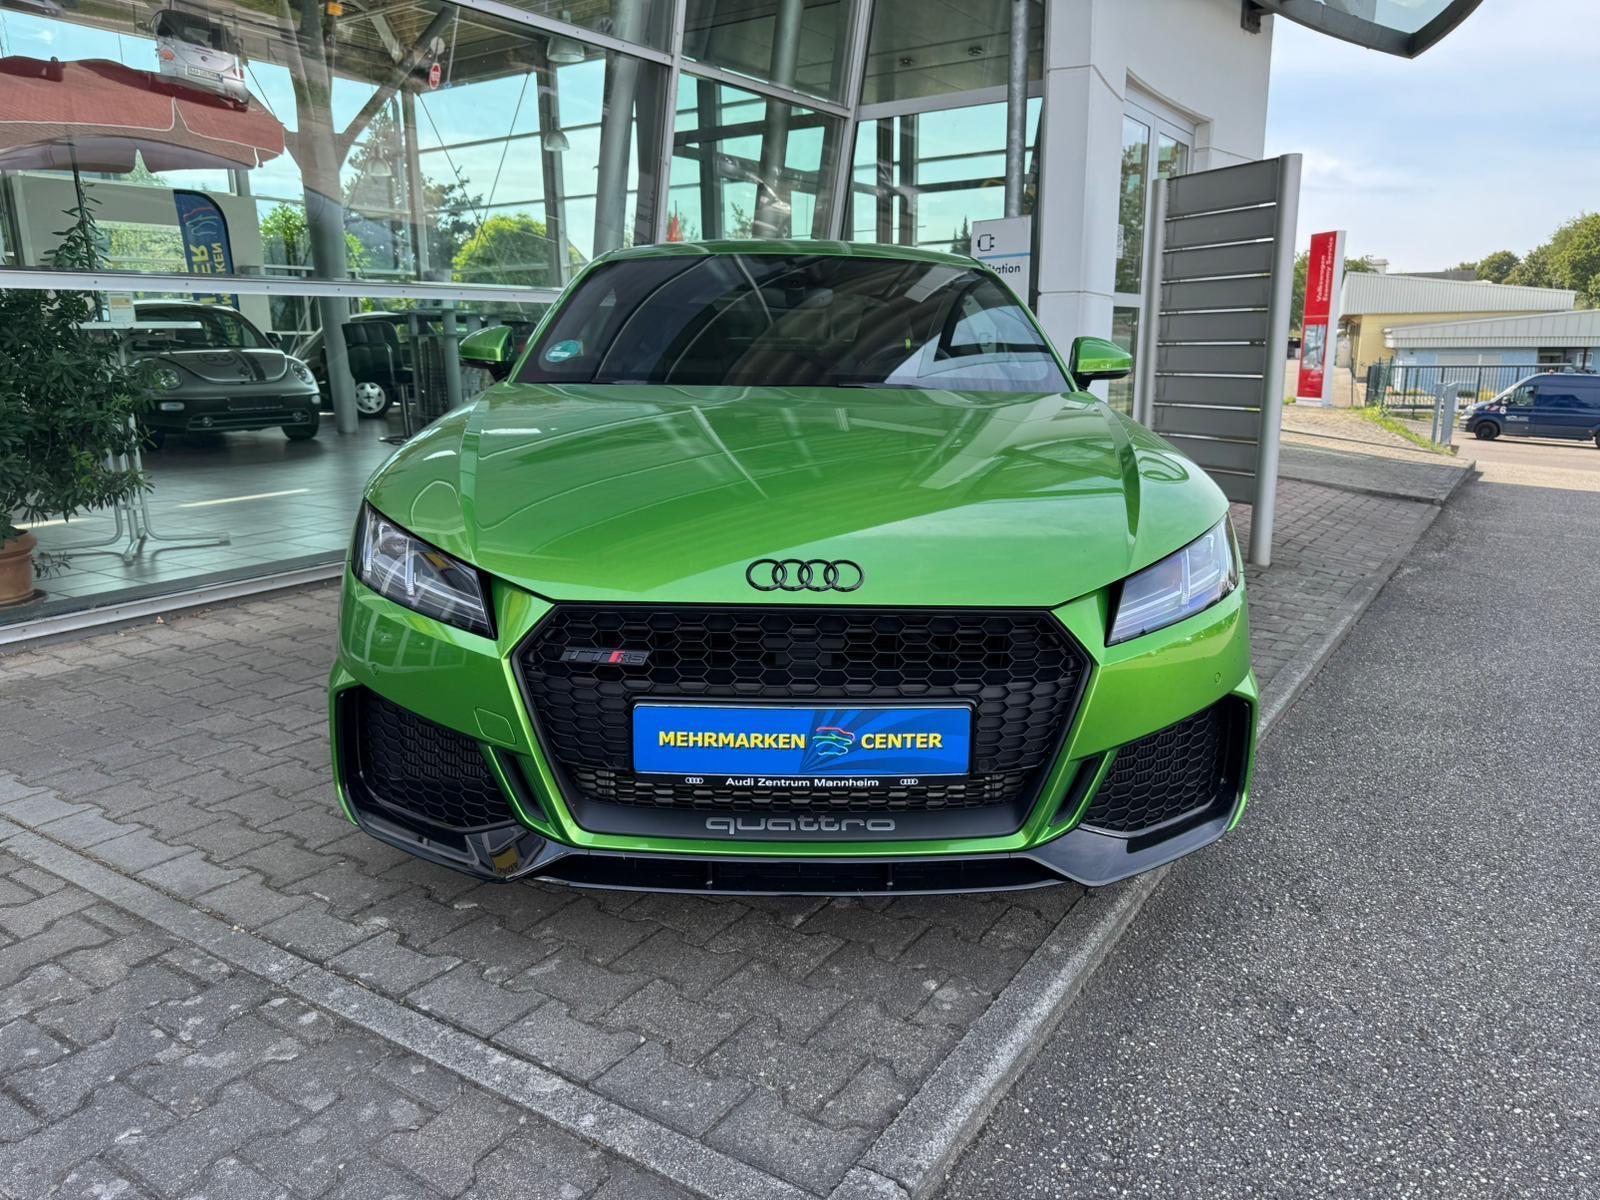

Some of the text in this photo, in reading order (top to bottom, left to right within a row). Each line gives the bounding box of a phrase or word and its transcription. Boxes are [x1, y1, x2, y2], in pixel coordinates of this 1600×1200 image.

[988, 263, 1021, 273] tation
[658, 731, 943, 749] MEHRMARKEN CENTER
[725, 777, 879, 787] Audi Zentrum Mannheim
[705, 815, 896, 835] quattro
